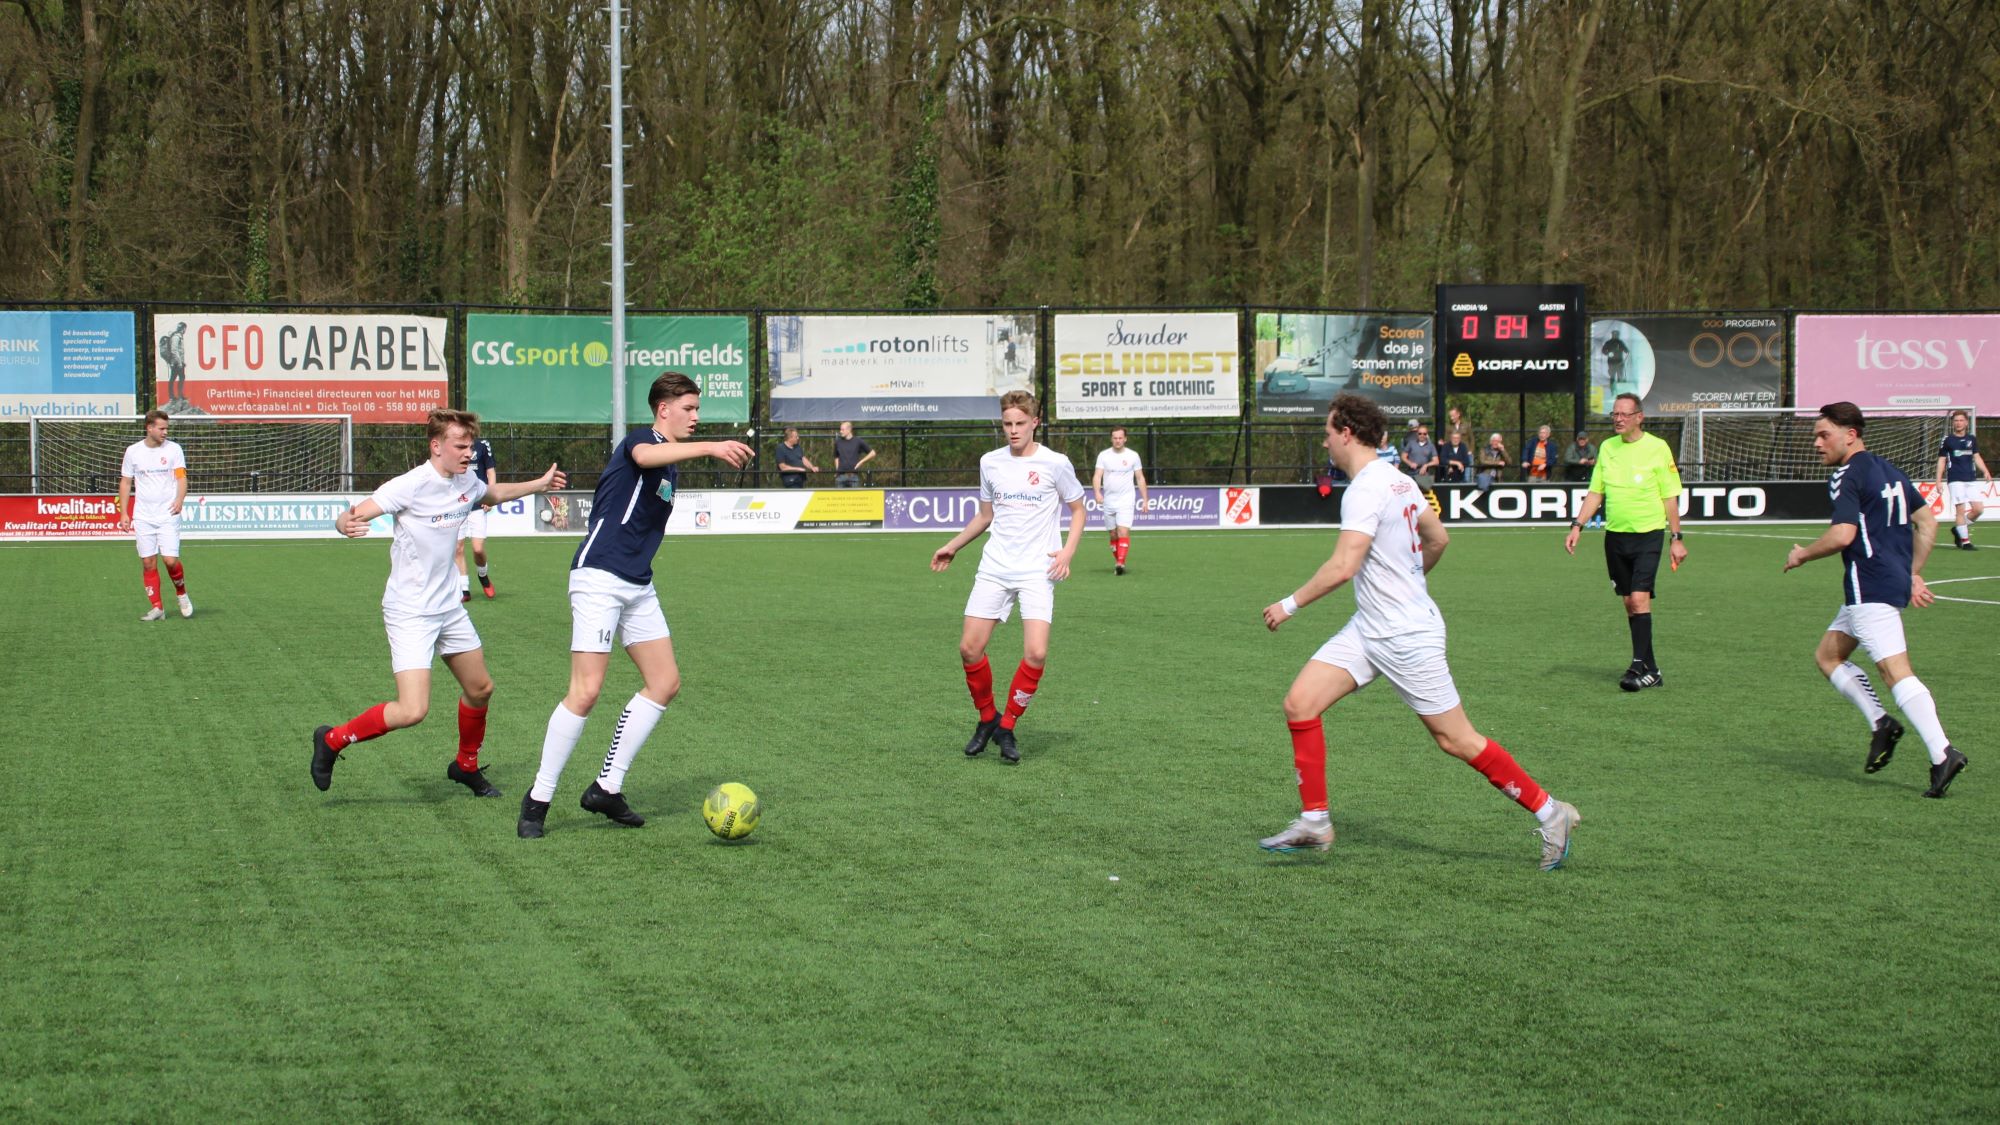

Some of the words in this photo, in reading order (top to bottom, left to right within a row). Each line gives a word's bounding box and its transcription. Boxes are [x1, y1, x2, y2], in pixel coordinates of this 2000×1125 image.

[1539, 303, 1566, 311] GASTEN
[1462, 316, 1478, 339] 0
[1495, 315, 1527, 339] 84
[1544, 316, 1560, 339] 5
[1725, 319, 1776, 327] PROGENTA
[1107, 319, 1188, 347] Sander
[1380, 326, 1424, 339] Scoren
[198, 324, 263, 370] CFO
[279, 325, 440, 371] CAPABEL
[870, 335, 969, 353] rotonlifts
[1383, 341, 1408, 355] doe
[1412, 342, 1424, 358] je
[1855, 330, 1948, 370] tess
[624, 343, 743, 366] reenfields
[821, 358, 878, 366] maatwerk
[884, 357, 894, 365] in
[1060, 352, 1236, 375] SELHORST
[1352, 361, 1394, 370] samen
[1397, 359, 1424, 370] met
[1478, 360, 1522, 370] KORF
[1524, 360, 1569, 370] AUTO
[708, 382, 743, 390] EVERY
[1361, 373, 1424, 388] Progenta!
[206, 389, 260, 399] (Parttime-)
[263, 389, 313, 398] Financieel
[317, 389, 372, 398] directeuren
[400, 389, 415, 398] het
[418, 389, 440, 398] MKB
[708, 390, 743, 398] PLAYER
[1082, 382, 1126, 397] SPORT
[1133, 381, 1142, 396] &
[1150, 380, 1215, 396] COACHING
[1692, 392, 1732, 402] SCOREN
[1733, 392, 1755, 401] MET
[1757, 392, 1776, 401] EEN
[210, 402, 302, 412] www.cfocapabel.nl
[317, 402, 338, 412] Dick
[342, 402, 361, 411] Tool
[364, 402, 375, 411] 06
[386, 402, 405, 411] 558
[406, 402, 417, 411] 90
[861, 403, 938, 413] www.rotonlifts.eu
[38, 499, 116, 514] kwalitaria
[1881, 481, 1907, 526] 11
[732, 512, 781, 520] ESSEVELD
[5, 522, 57, 530] Kwalitaria
[60, 521, 114, 530] Délifrance
[598, 629, 611, 644] 14
